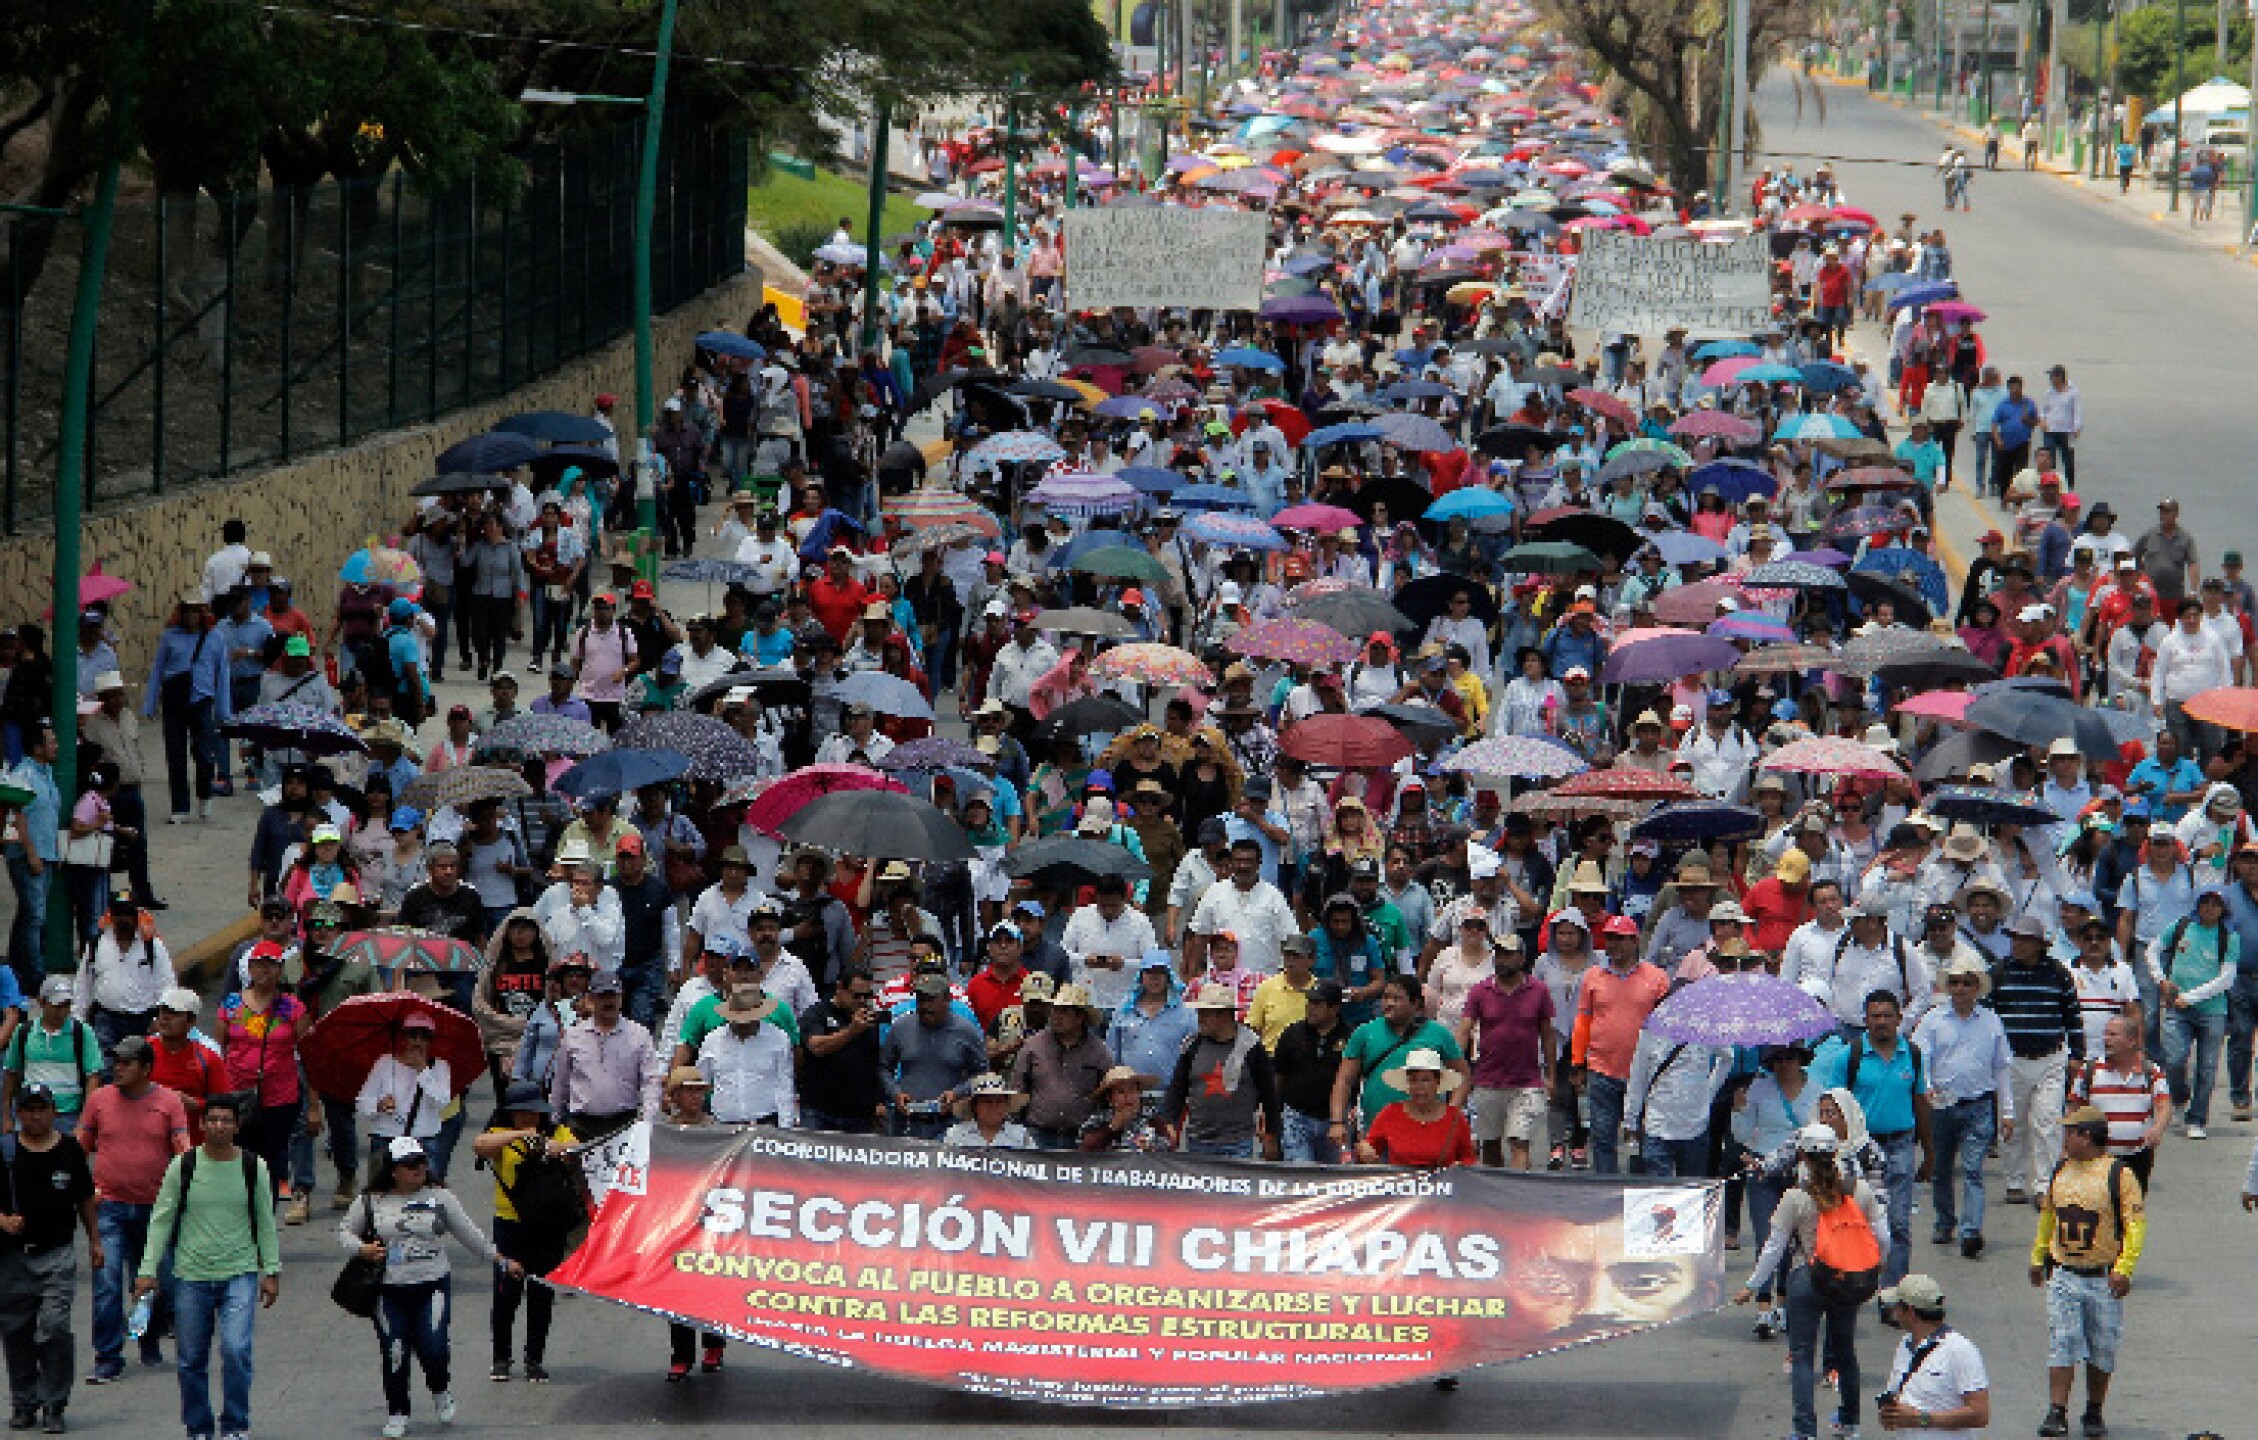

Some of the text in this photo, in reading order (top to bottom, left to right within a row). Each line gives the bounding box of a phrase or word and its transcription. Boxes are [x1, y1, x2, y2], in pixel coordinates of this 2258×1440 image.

[753, 1137, 929, 1169] COORDINADORA
[937, 1152, 1048, 1181] NACIONAL
[1056, 1164, 1082, 1183] DE
[1091, 1167, 1250, 1195] TRABAJADORES
[1258, 1179, 1288, 1195] DE
[1293, 1182, 1317, 1195] LA
[703, 1188, 1499, 1280] SECCIÓN VII CHIAPAS
[674, 1252, 1506, 1318] CONVOCA AL PUEBLO A ORGANIZARSE Y LUCHAR
[746, 1290, 1429, 1343] CONTRA LAS REFORMAS ESTRUCTURALES
[875, 1332, 975, 1351] HUELGA
[983, 1341, 1139, 1359] MAGISTERIAL
[1148, 1348, 1165, 1361] Y
[1173, 1351, 1286, 1364] POPULAR
